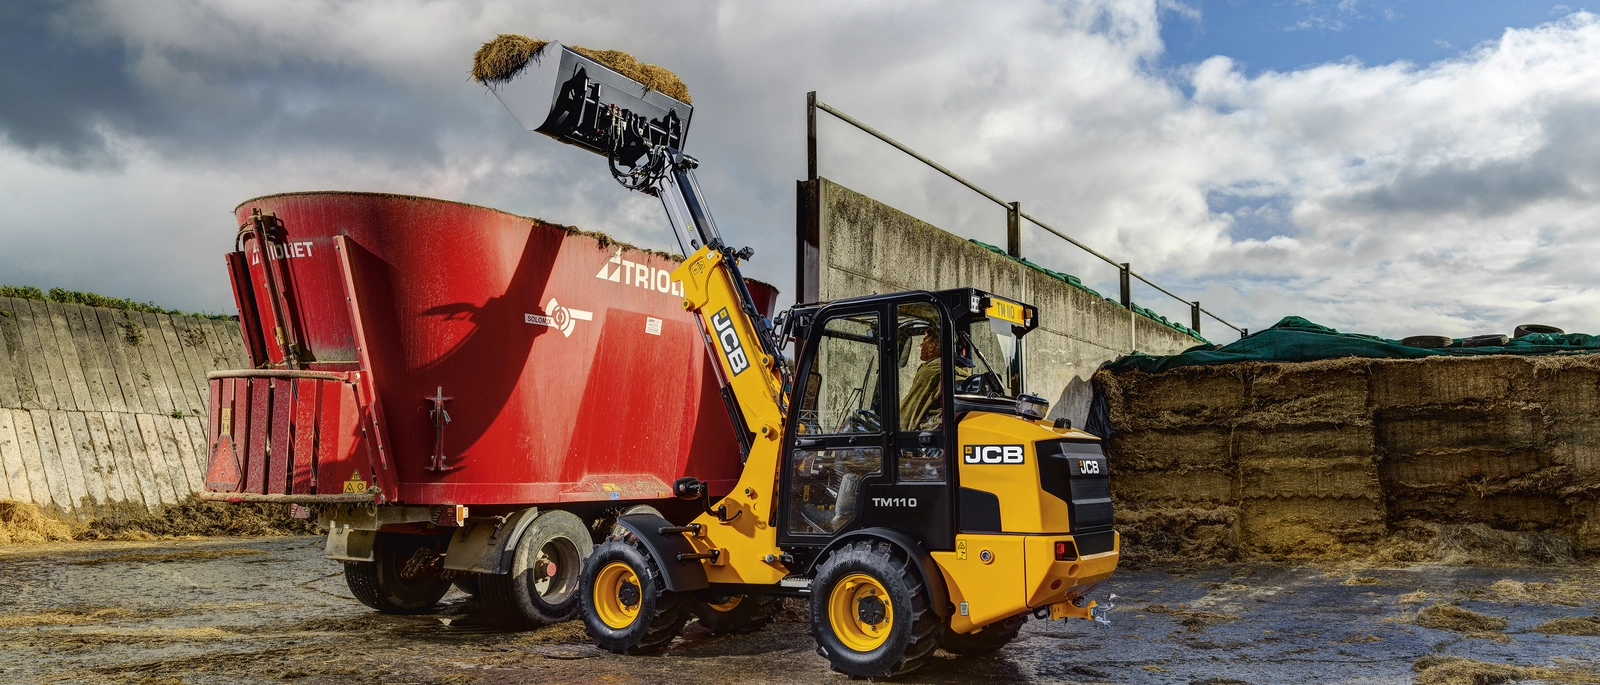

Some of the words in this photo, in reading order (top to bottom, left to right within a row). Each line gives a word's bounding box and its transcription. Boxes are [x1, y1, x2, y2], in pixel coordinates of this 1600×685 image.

[266, 241, 313, 260] IOLIET
[622, 259, 685, 298] TRIOLI
[527, 315, 552, 325] SOLOMIX
[713, 314, 748, 374] JCB
[965, 446, 1024, 463] JCB
[1080, 460, 1100, 474] JCB
[872, 497, 918, 507] TM110
